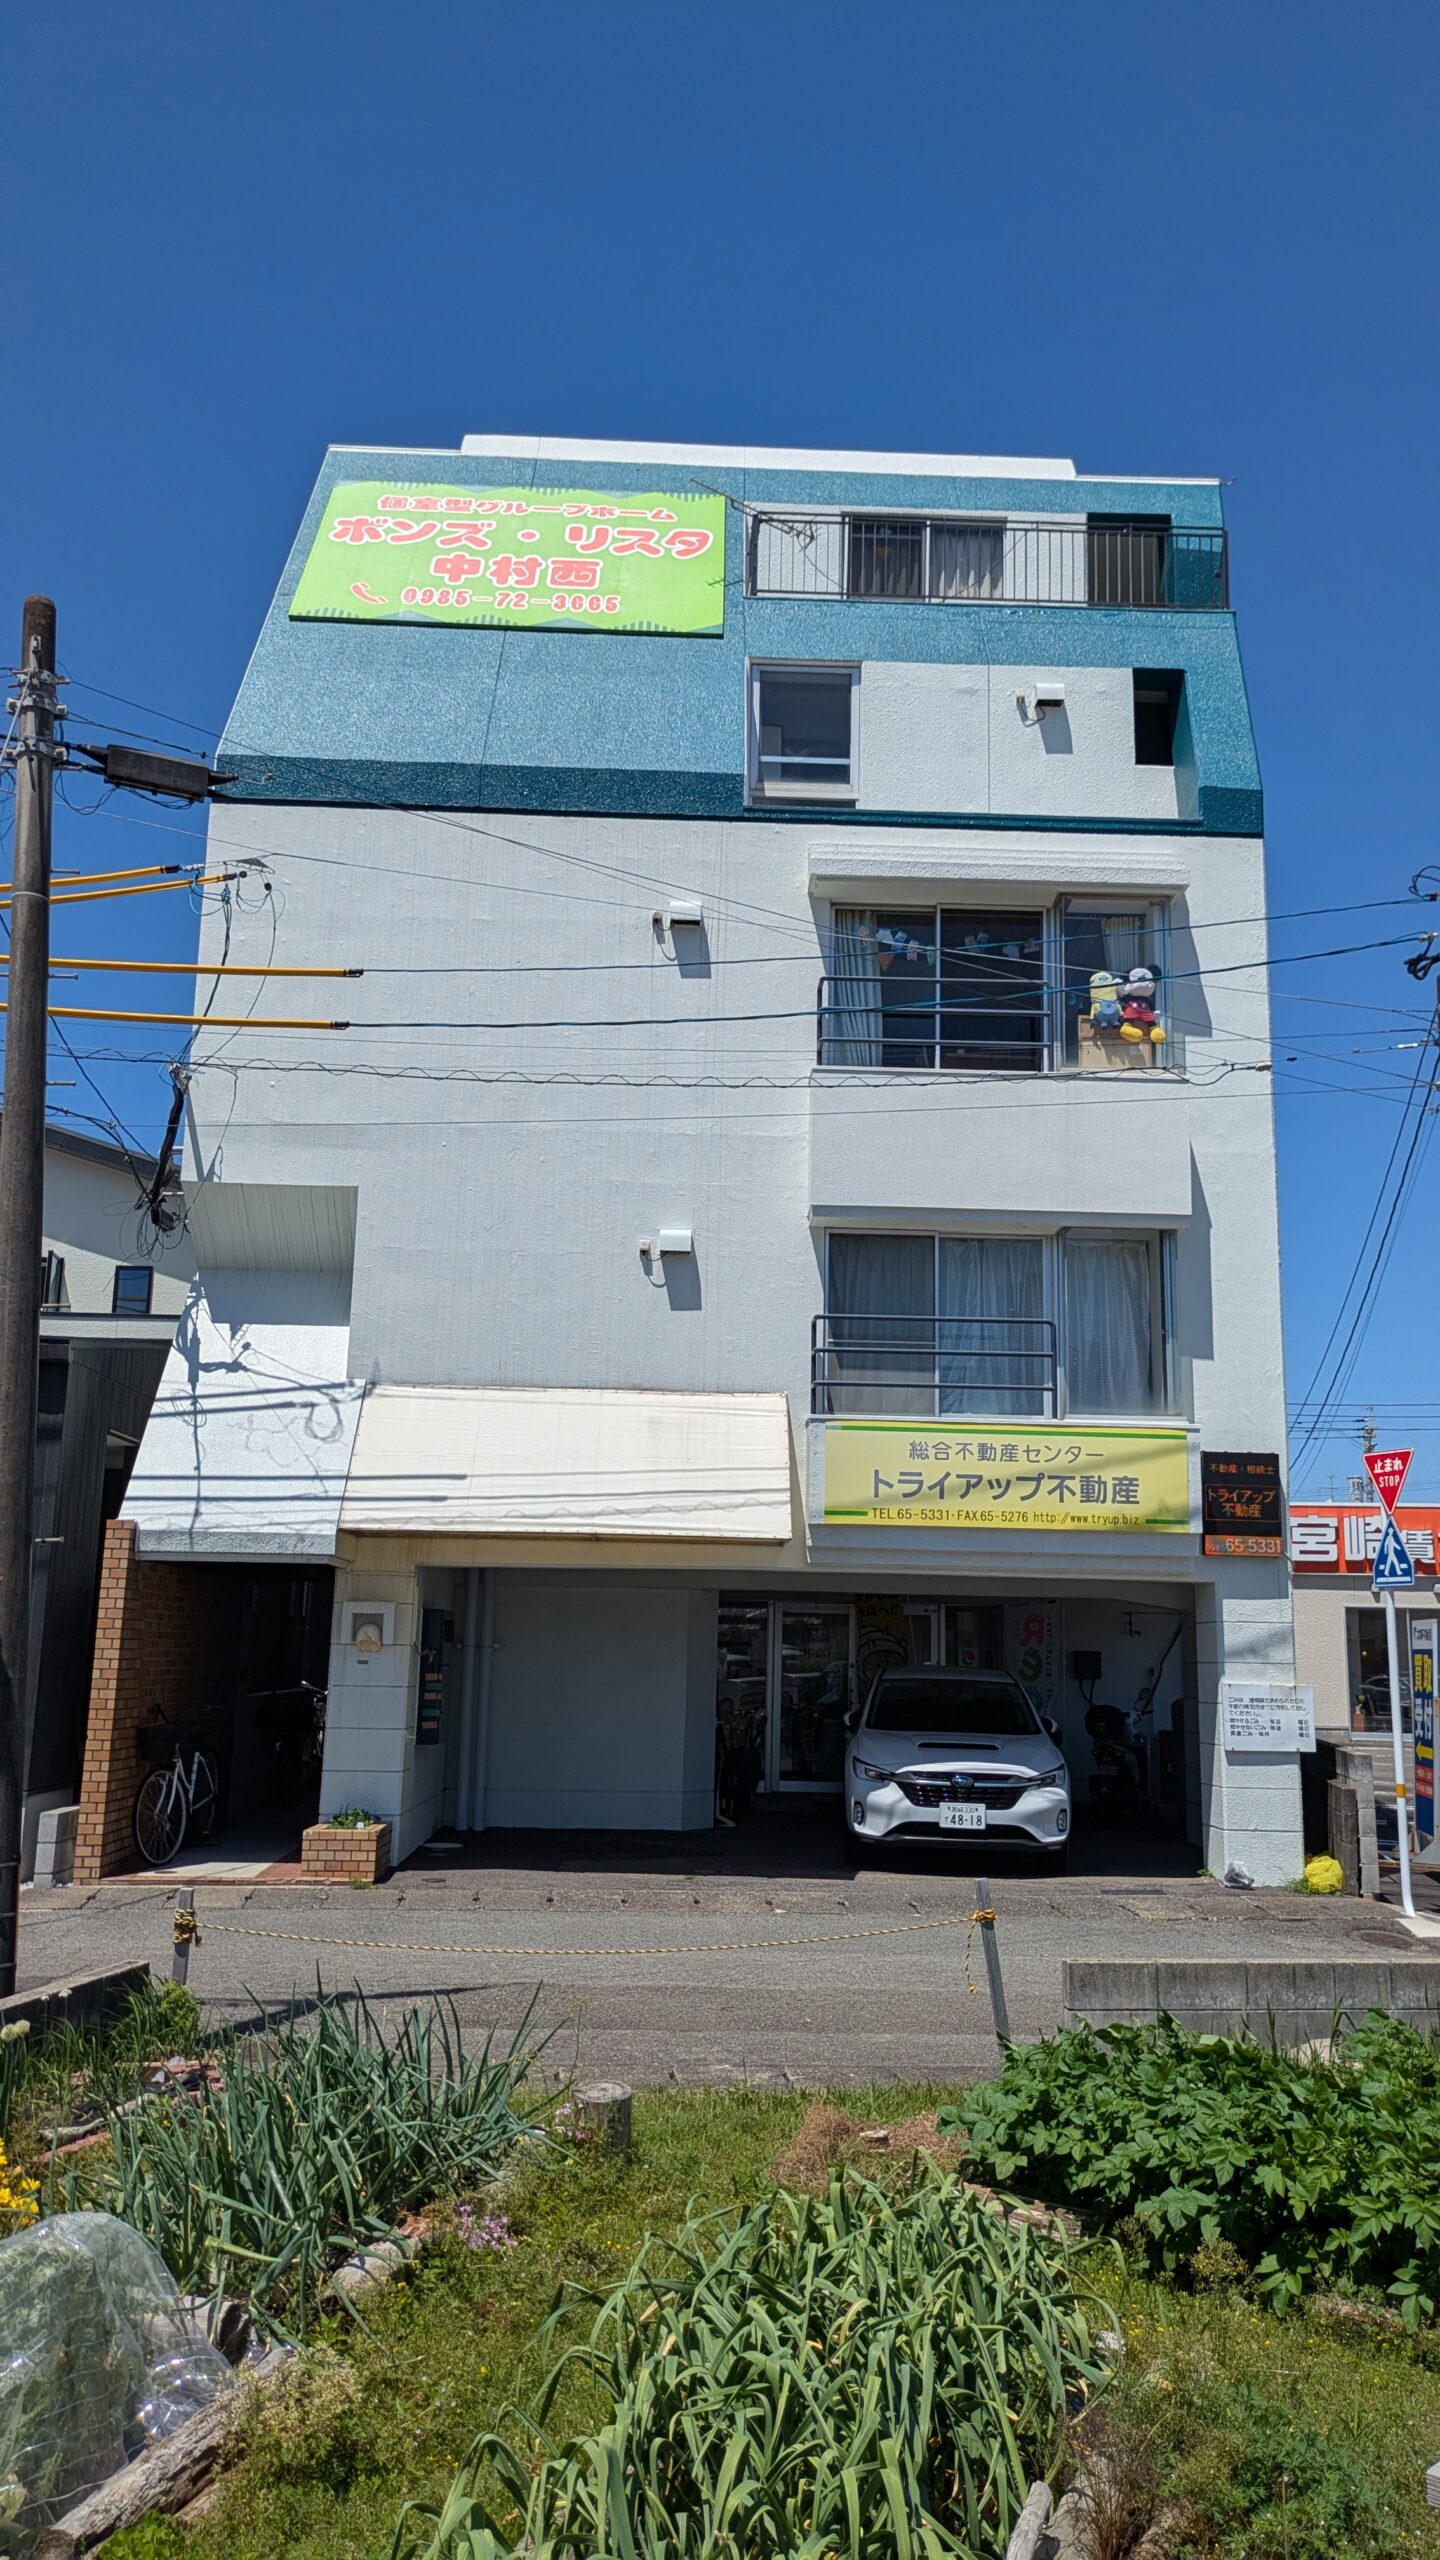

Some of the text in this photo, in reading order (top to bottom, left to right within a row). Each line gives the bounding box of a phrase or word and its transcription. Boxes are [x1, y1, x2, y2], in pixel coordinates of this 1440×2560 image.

[378, 496, 677, 521] 個室型グループホーム
[330, 516, 712, 556] ボンズ・リスタ
[431, 553, 601, 588] 中村西
[909, 1440, 1104, 1464] 総合不動産センター
[1373, 1457, 1404, 1474] 止まれ
[873, 1469, 1140, 1505] トライアップ不動産
[1378, 1475, 1400, 1488] STOP
[1208, 1488, 1277, 1503] トライアップ
[1222, 1503, 1262, 1517] 不動産
[950, 1814, 983, 1827] 48-18
